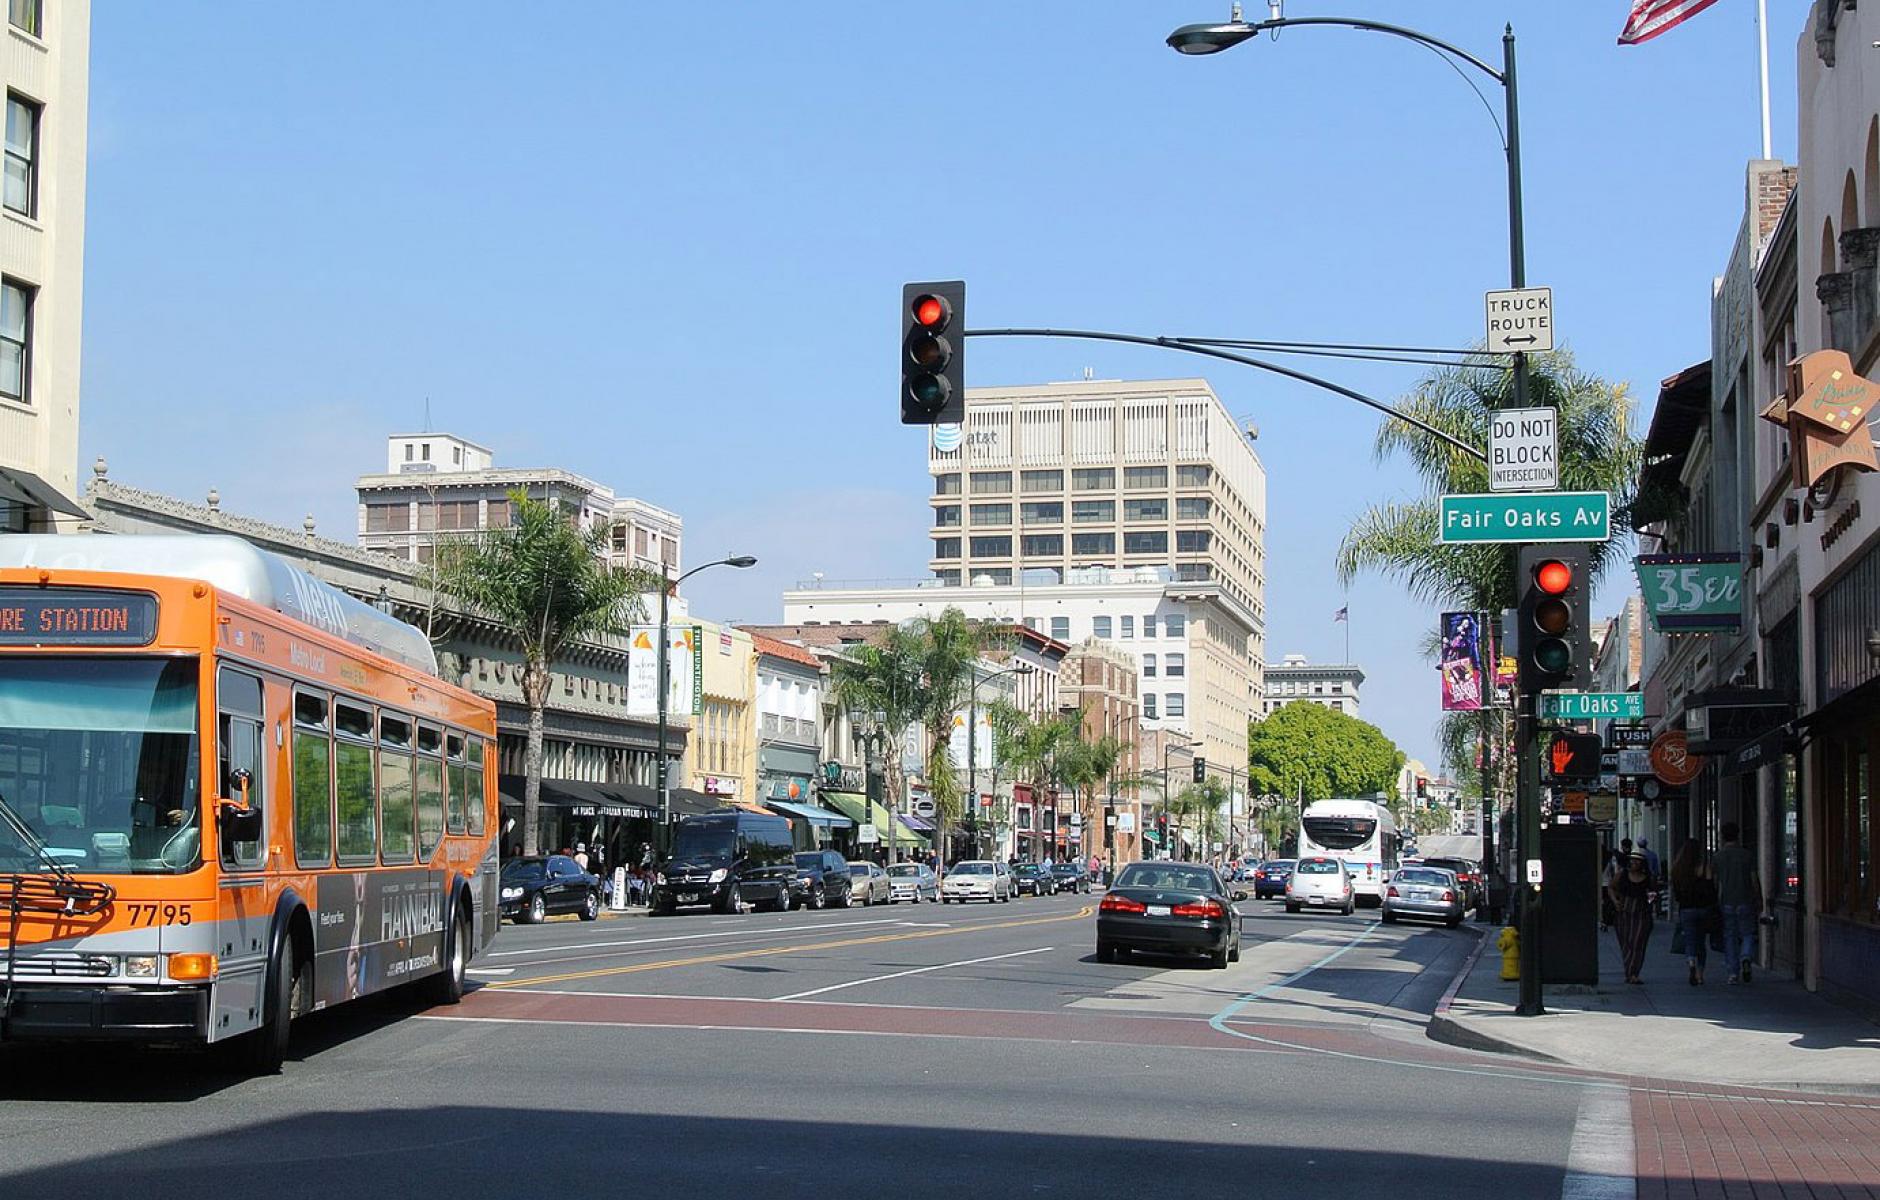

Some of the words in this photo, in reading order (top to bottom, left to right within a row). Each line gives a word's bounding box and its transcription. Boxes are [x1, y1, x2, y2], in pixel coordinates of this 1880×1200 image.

[1490, 297, 1549, 312] TRUCK
[1490, 316, 1549, 331] ROUTE
[966, 431, 997, 445] at&t
[1494, 421, 1515, 439] DO
[1520, 419, 1552, 437] NOT
[1494, 445, 1553, 465] BLOCK
[1493, 468, 1553, 482] INTERSECTION
[1447, 510, 1493, 528] Fair
[1504, 508, 1561, 528] Oaks
[1573, 507, 1602, 526] Av
[1656, 567, 1740, 612] 35er
[0, 608, 25, 632] RE
[39, 607, 129, 632] STATION
[1543, 698, 1572, 713] Fair
[1580, 695, 1619, 713] Oaks
[1625, 695, 1640, 705] AVE
[1615, 731, 1650, 740] LUSH
[127, 904, 192, 926] 7795
[381, 892, 443, 942] HANNIBAL
